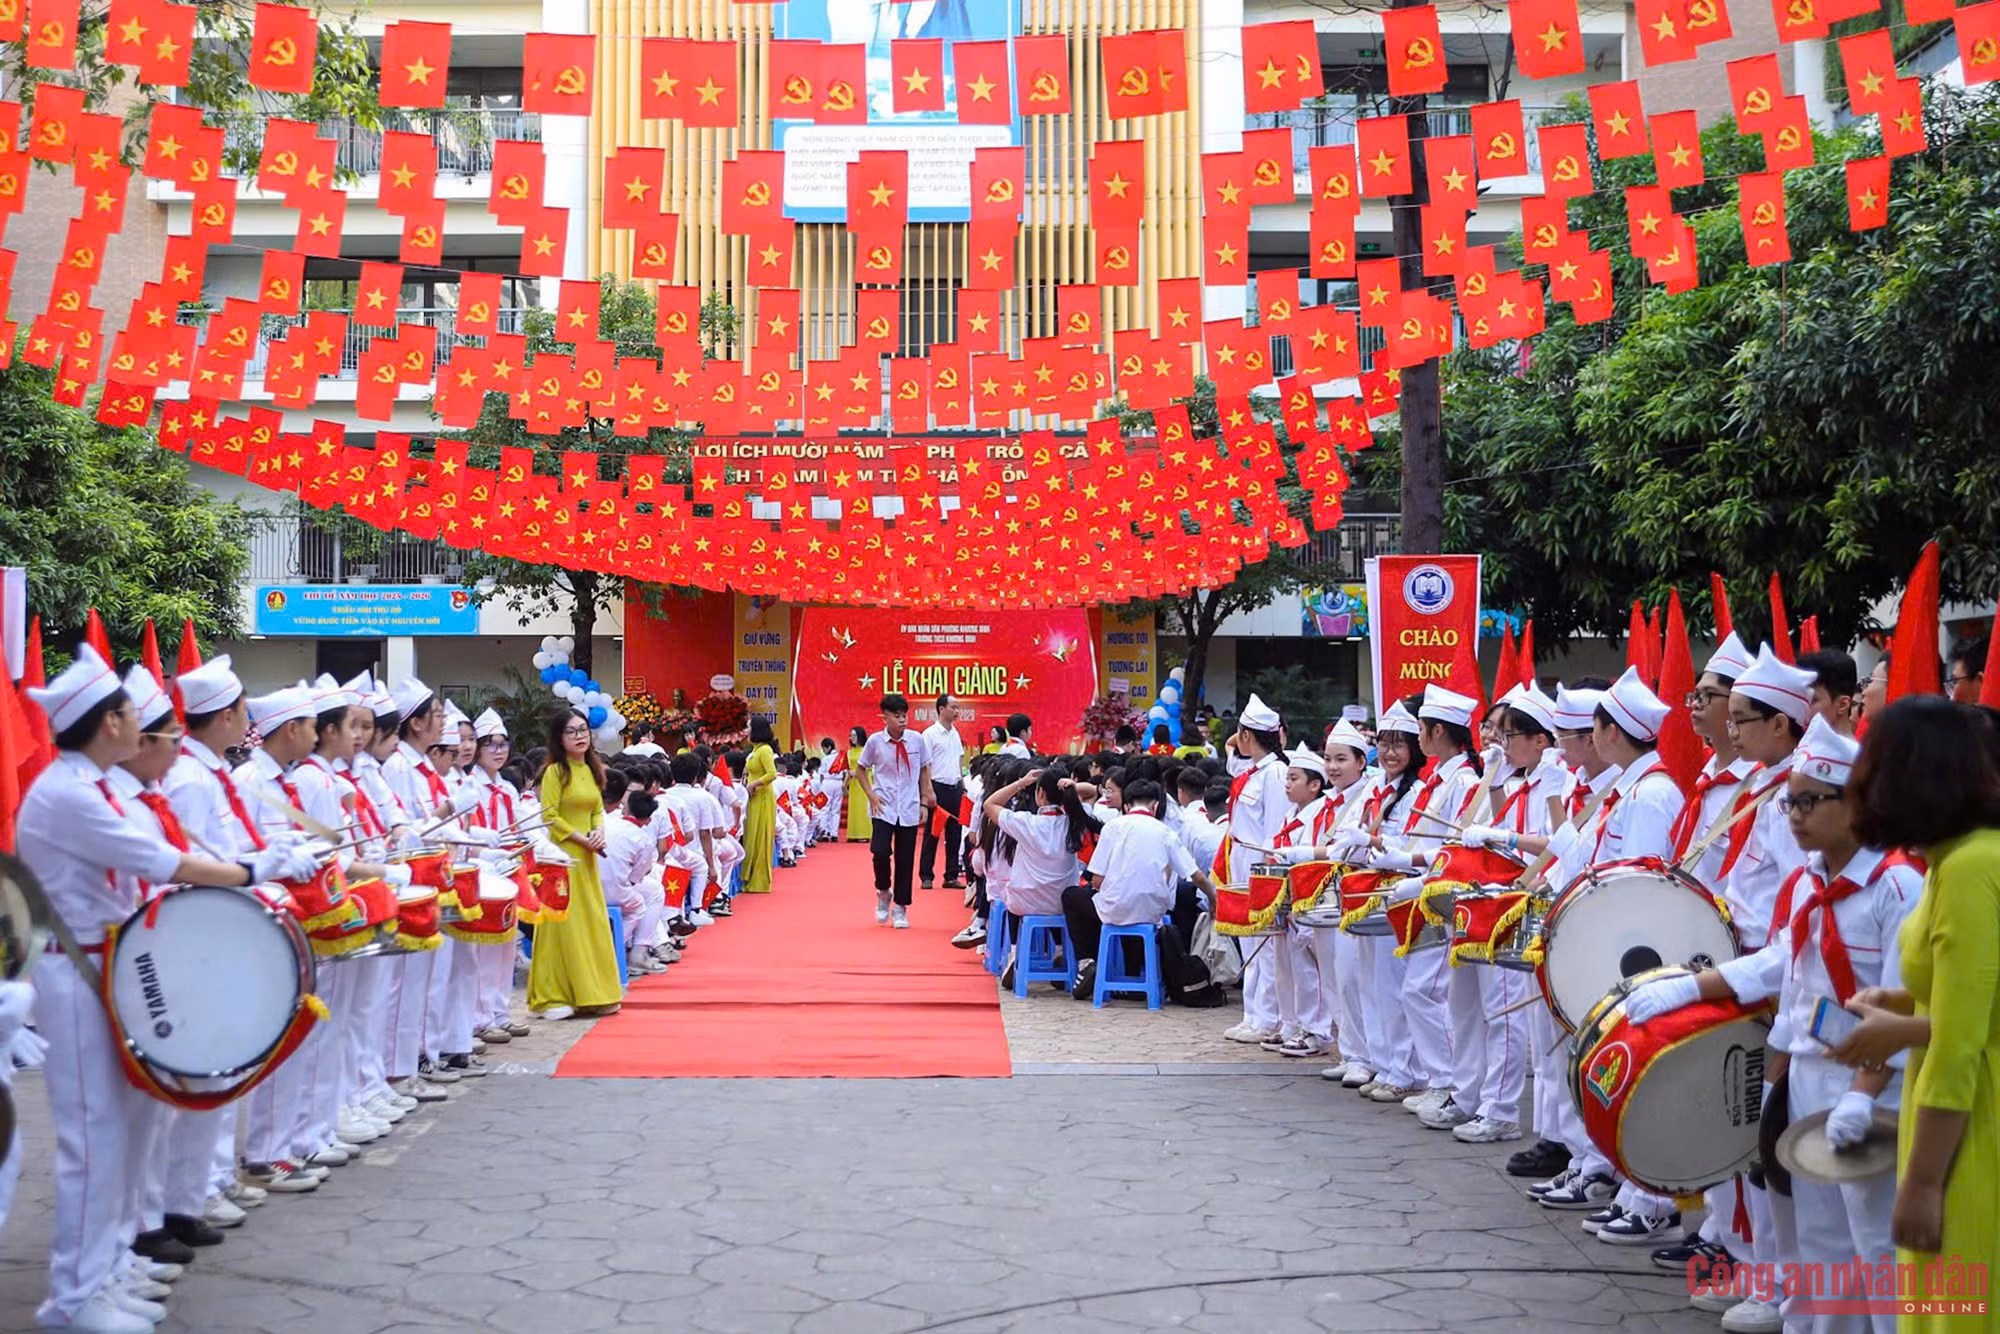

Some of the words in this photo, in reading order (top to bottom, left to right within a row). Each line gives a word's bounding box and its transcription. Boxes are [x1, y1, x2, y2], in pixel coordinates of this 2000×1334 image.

[733, 442, 767, 458] ÍCH
[1059, 443, 1089, 458] CÂ
[411, 591, 431, 601] 2026
[1400, 625, 1459, 646] CHÀO
[882, 659, 904, 695] LỄ
[908, 665, 948, 696] KHAI
[953, 661, 1008, 696] GIẢNG
[1136, 661, 1148, 673] LAI
[134, 952, 168, 1020] YAMAHA
[1745, 1047, 1764, 1125] VICTORIA
